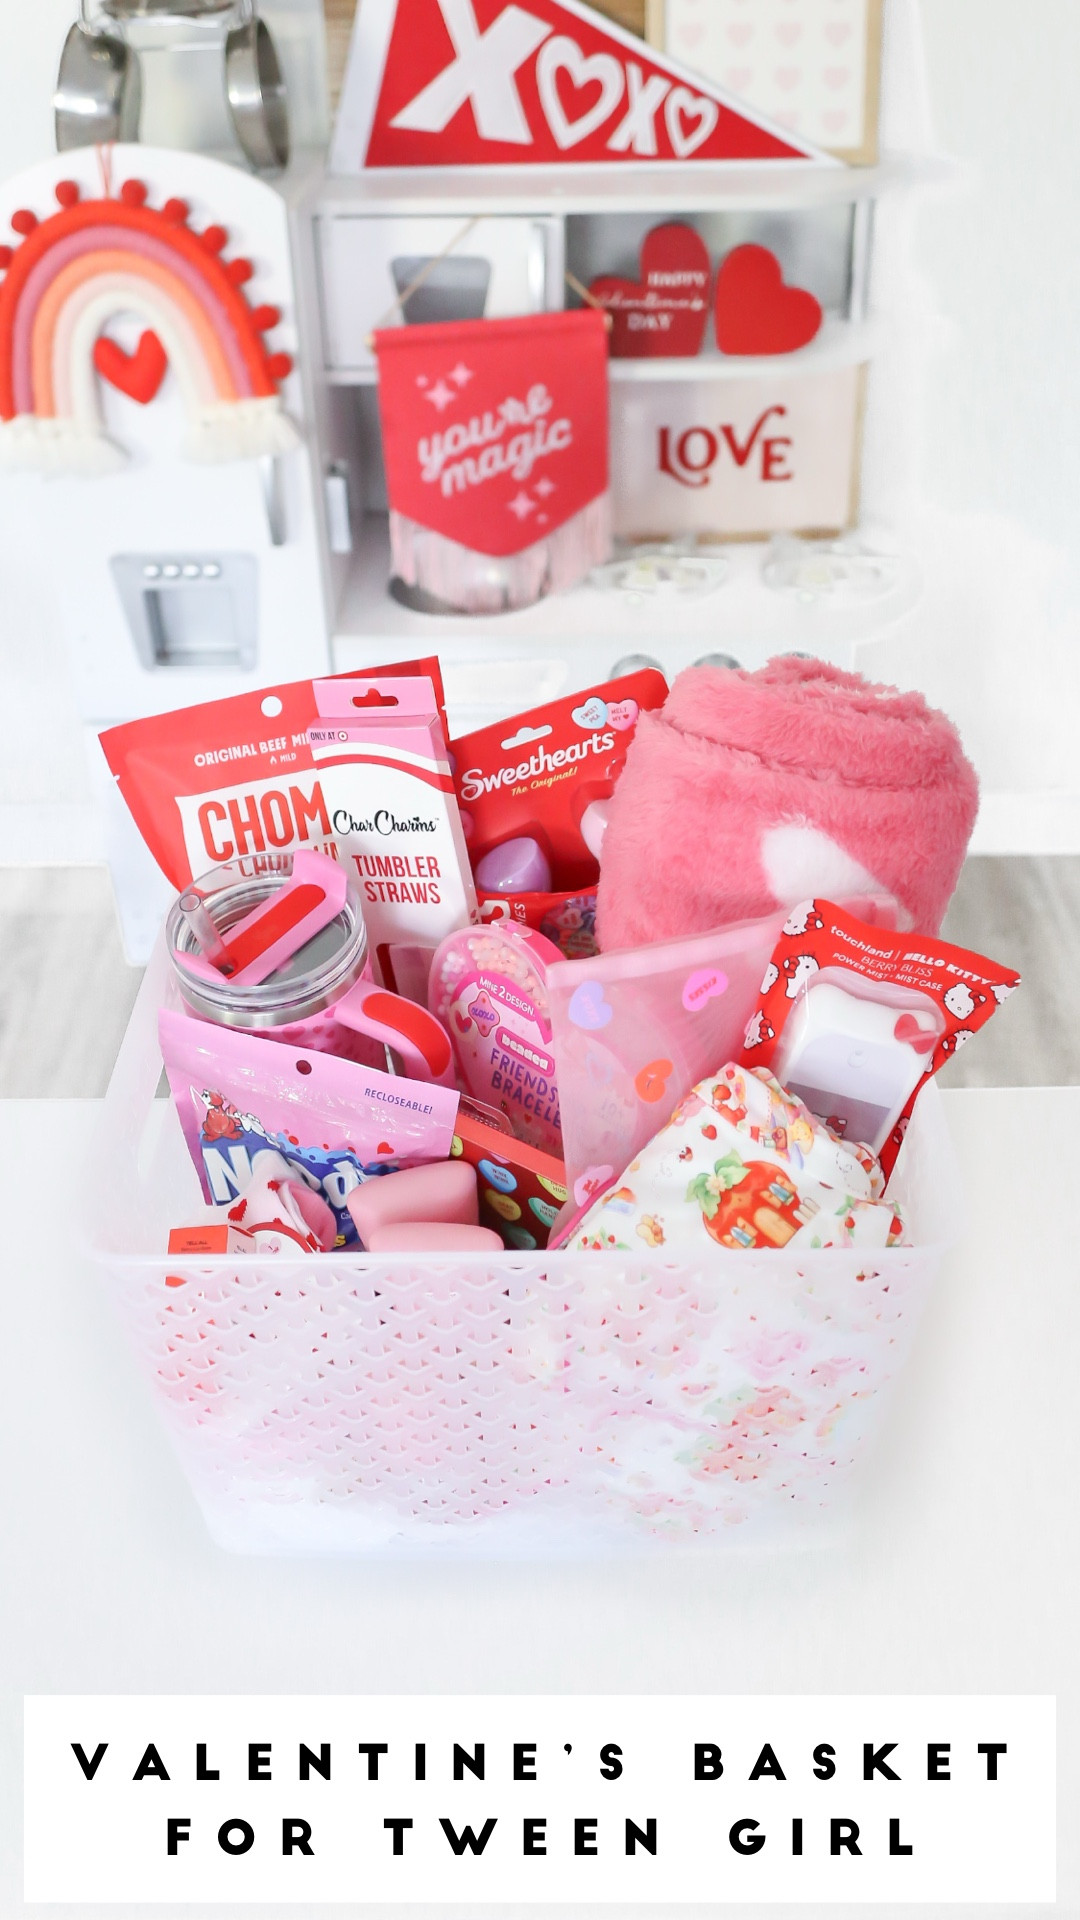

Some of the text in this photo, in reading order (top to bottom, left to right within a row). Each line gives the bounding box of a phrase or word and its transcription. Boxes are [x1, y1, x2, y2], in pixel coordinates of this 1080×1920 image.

[628, 312, 673, 331] DAY
[441, 418, 572, 498] magic
[659, 405, 793, 488] LOVE
[311, 732, 335, 740] ONLY AT
[194, 744, 257, 767] ORIGINAL
[259, 737, 287, 753] BEEF
[280, 753, 297, 763] MILD
[461, 732, 615, 801] Sweethearts
[512, 766, 578, 796] The Original!
[333, 810, 437, 835] Char Charms
[352, 855, 441, 878] TUMBLER
[364, 881, 441, 904] STRAWS
[830, 925, 992, 985] touchland HELLO KITTY
[861, 956, 934, 978] BERRY BLISS
[832, 953, 944, 991] POWER MIST MIST CASE
[479, 976, 535, 1016] MINE 2 DESIGN
[364, 1088, 433, 1114] RECLOSEABLE!
